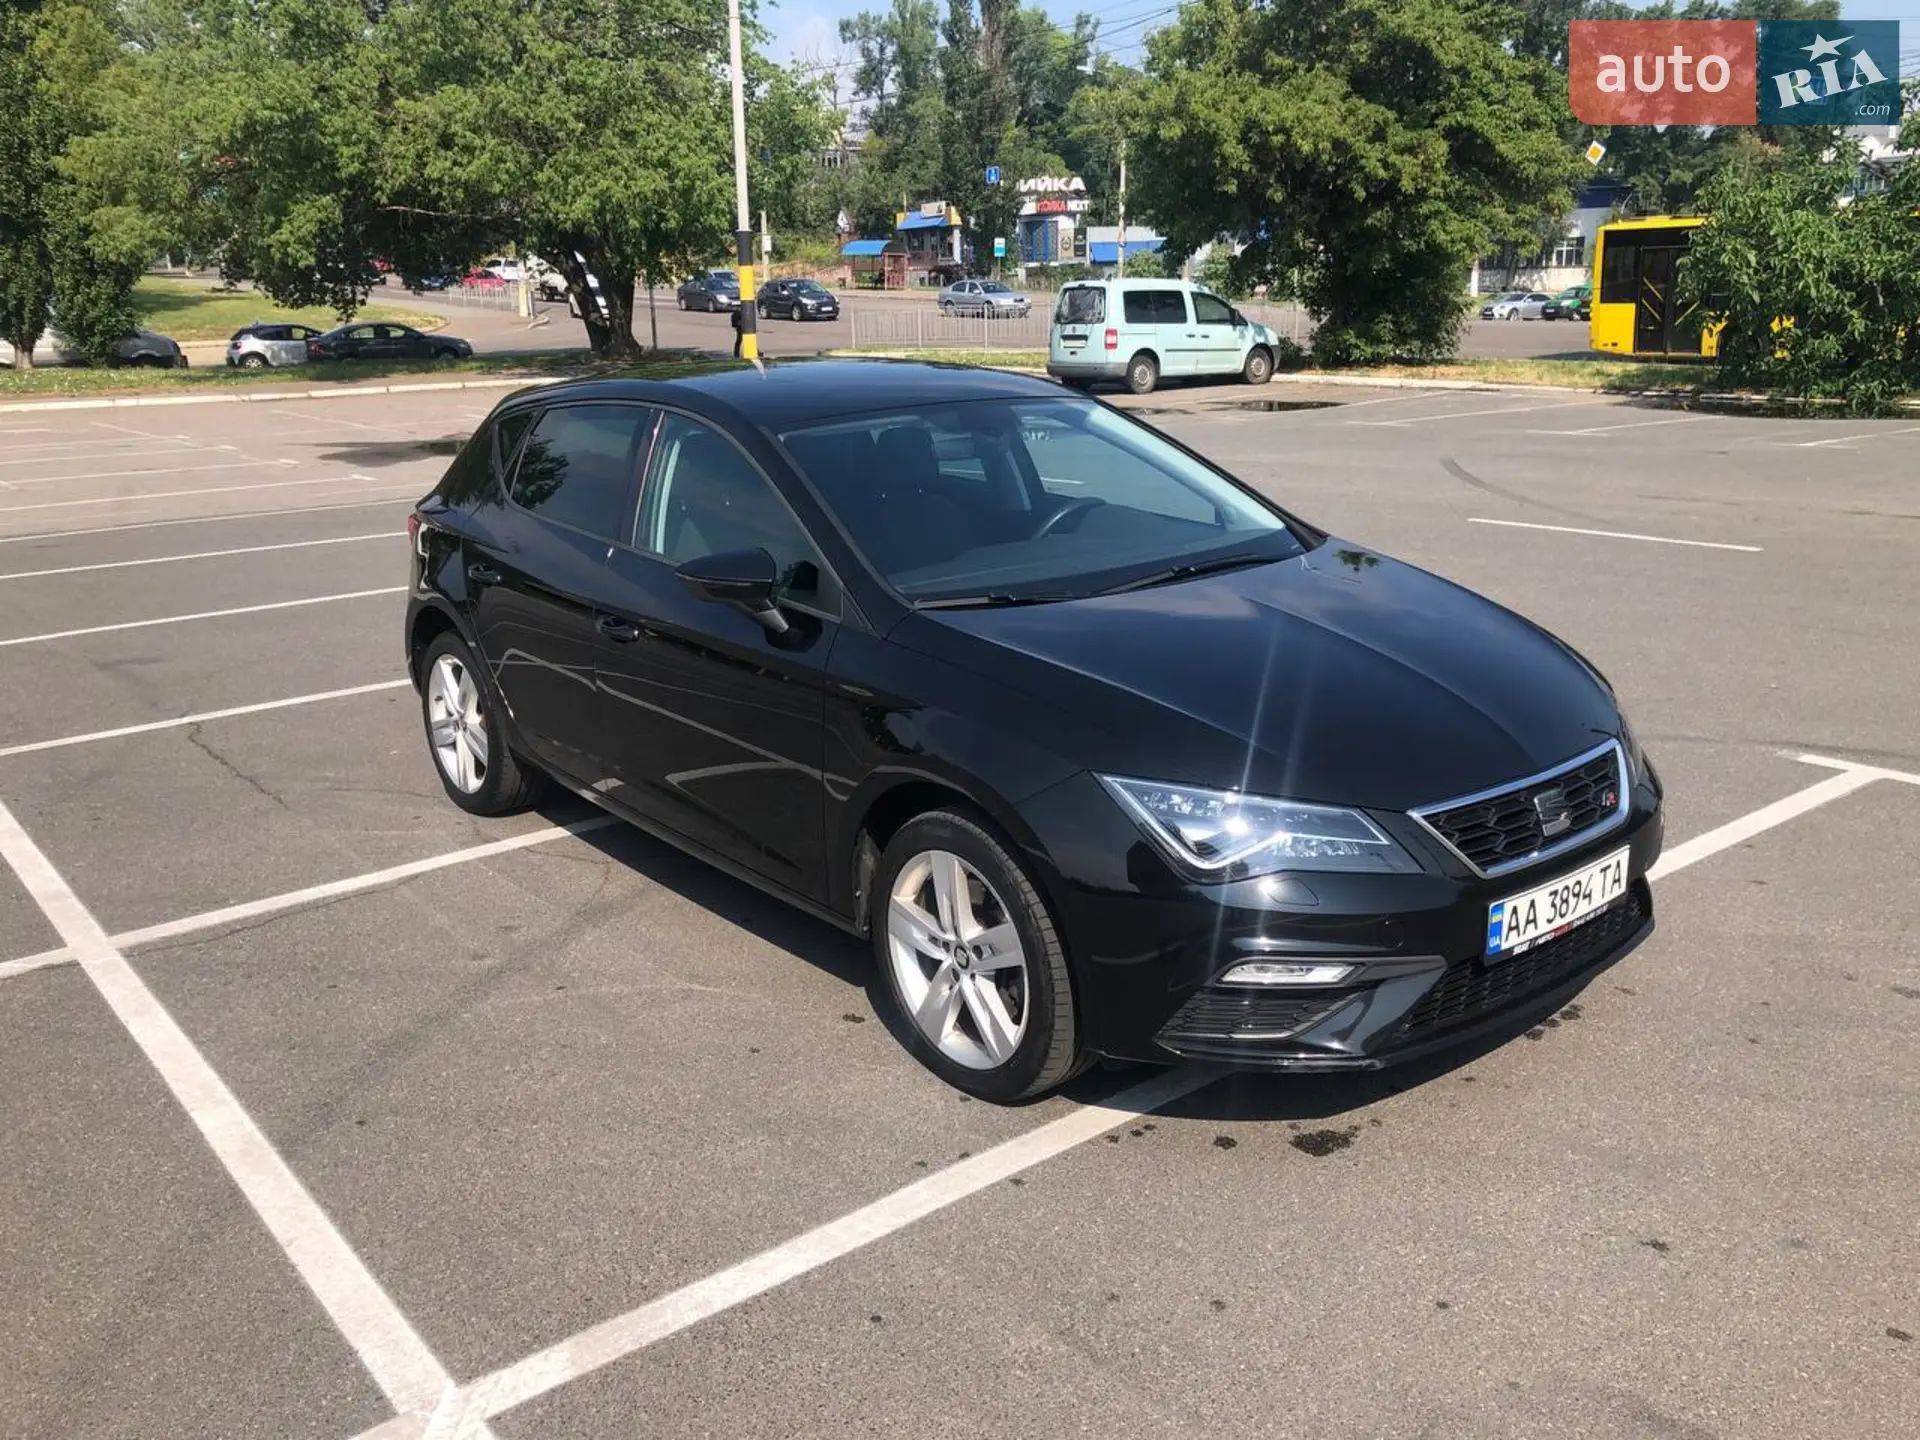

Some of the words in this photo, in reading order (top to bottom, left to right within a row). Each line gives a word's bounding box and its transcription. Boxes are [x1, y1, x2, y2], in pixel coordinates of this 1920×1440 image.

[1504, 898, 1538, 943] AA
[1546, 873, 1593, 924] 3894
[1599, 859, 1622, 899] TA
